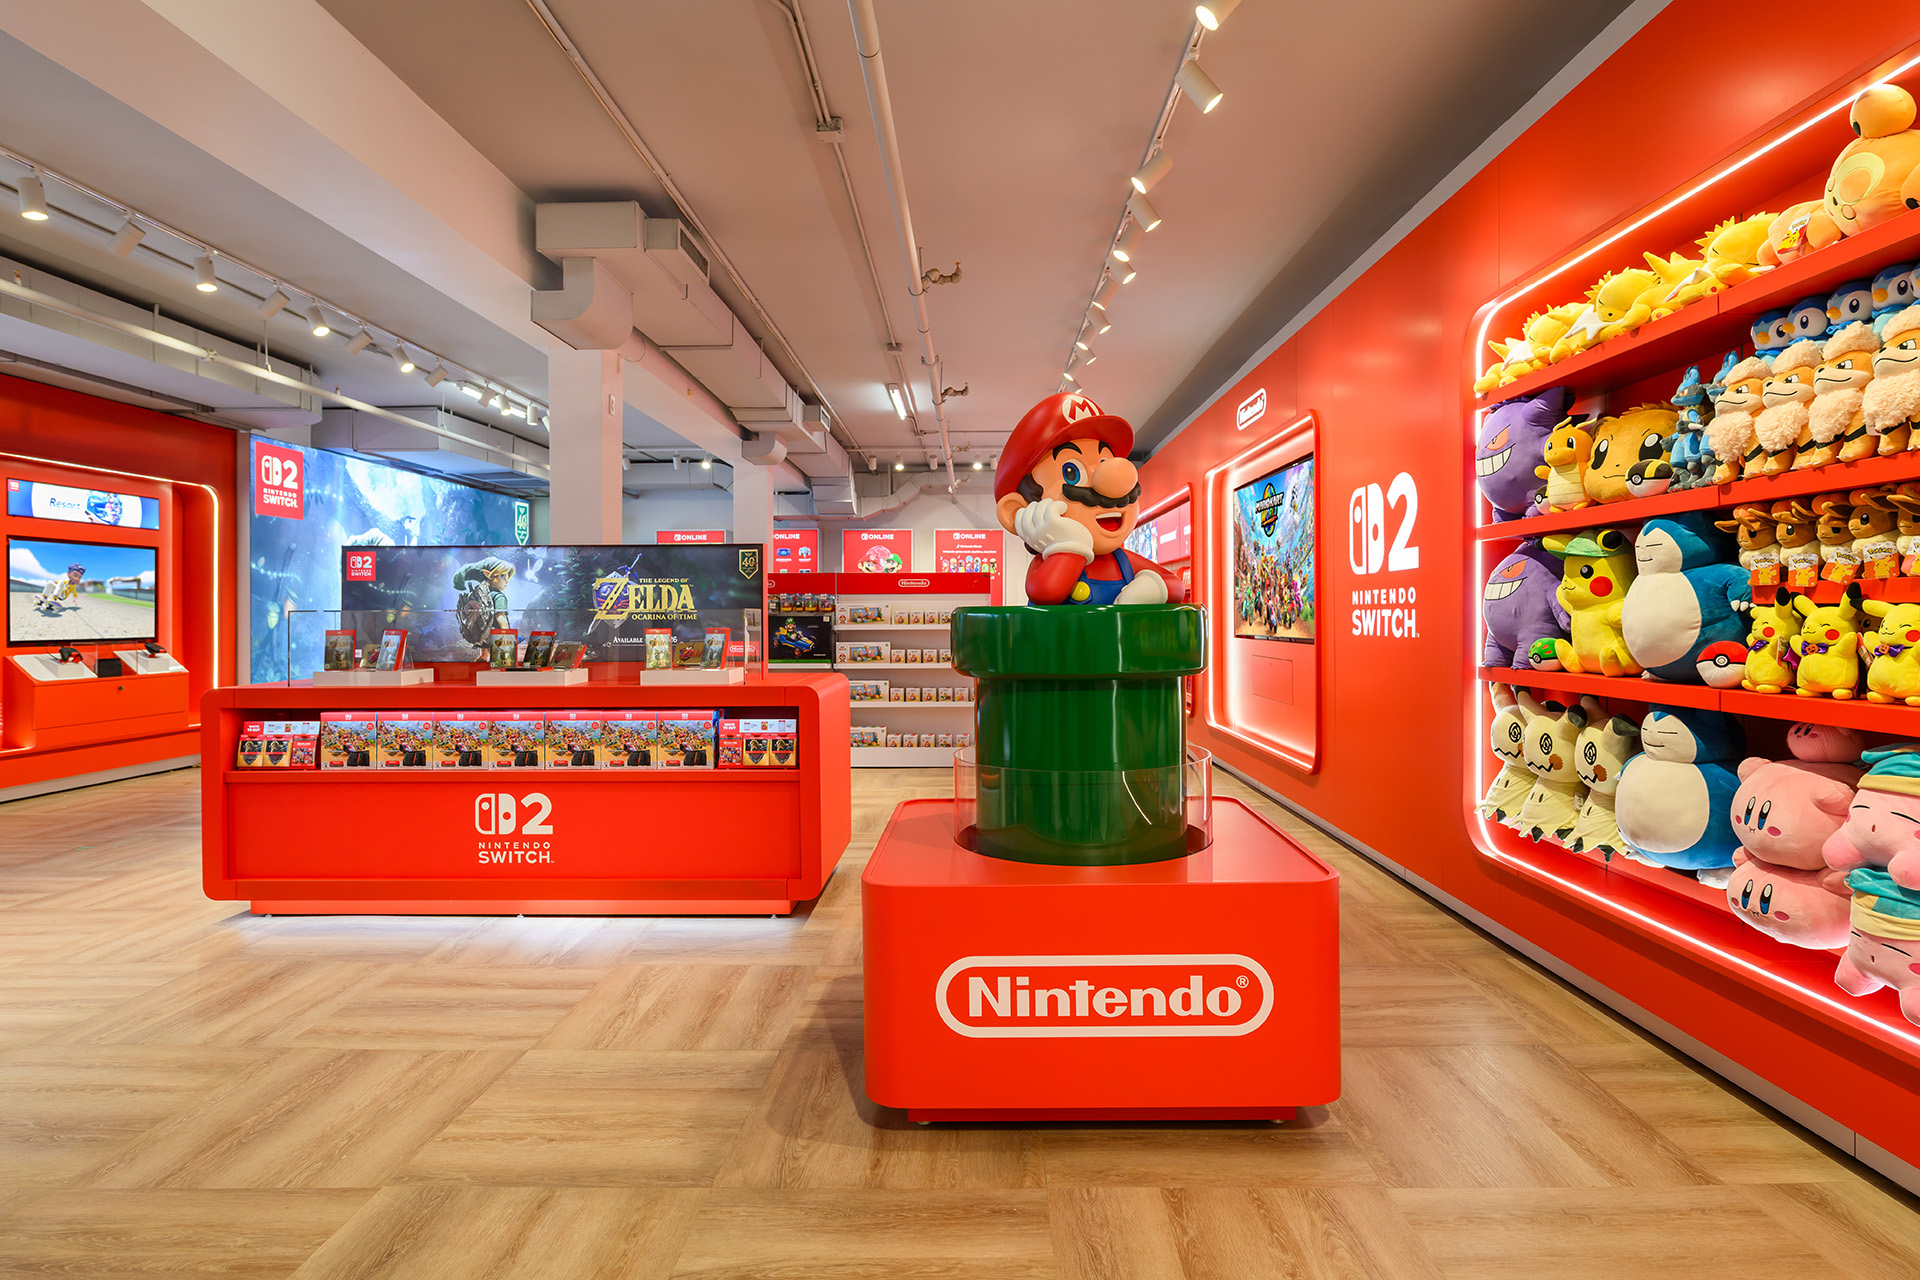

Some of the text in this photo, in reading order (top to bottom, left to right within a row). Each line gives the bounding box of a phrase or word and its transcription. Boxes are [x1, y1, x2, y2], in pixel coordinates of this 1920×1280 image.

[263, 487, 297, 499] NINTENDO
[1352, 586, 1416, 605] NINTENDO
[478, 841, 551, 850] NINTENDO
